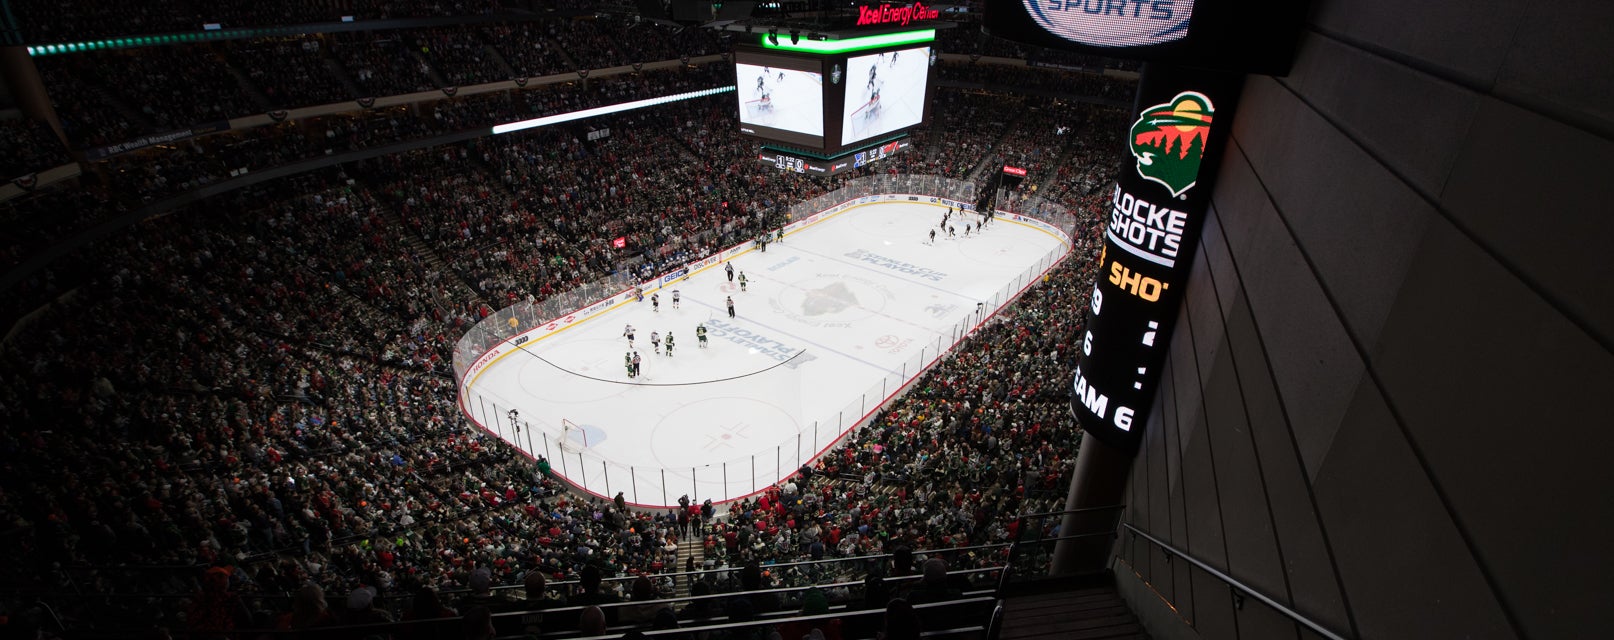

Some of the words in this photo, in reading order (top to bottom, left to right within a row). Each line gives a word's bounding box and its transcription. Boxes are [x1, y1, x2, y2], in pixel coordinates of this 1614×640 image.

[1113, 183, 1188, 235] LOCKE
[1110, 208, 1182, 257] SHOTS
[1109, 261, 1169, 302] SHO
[473, 349, 500, 374] HONDA
[1083, 330, 1093, 357] 6
